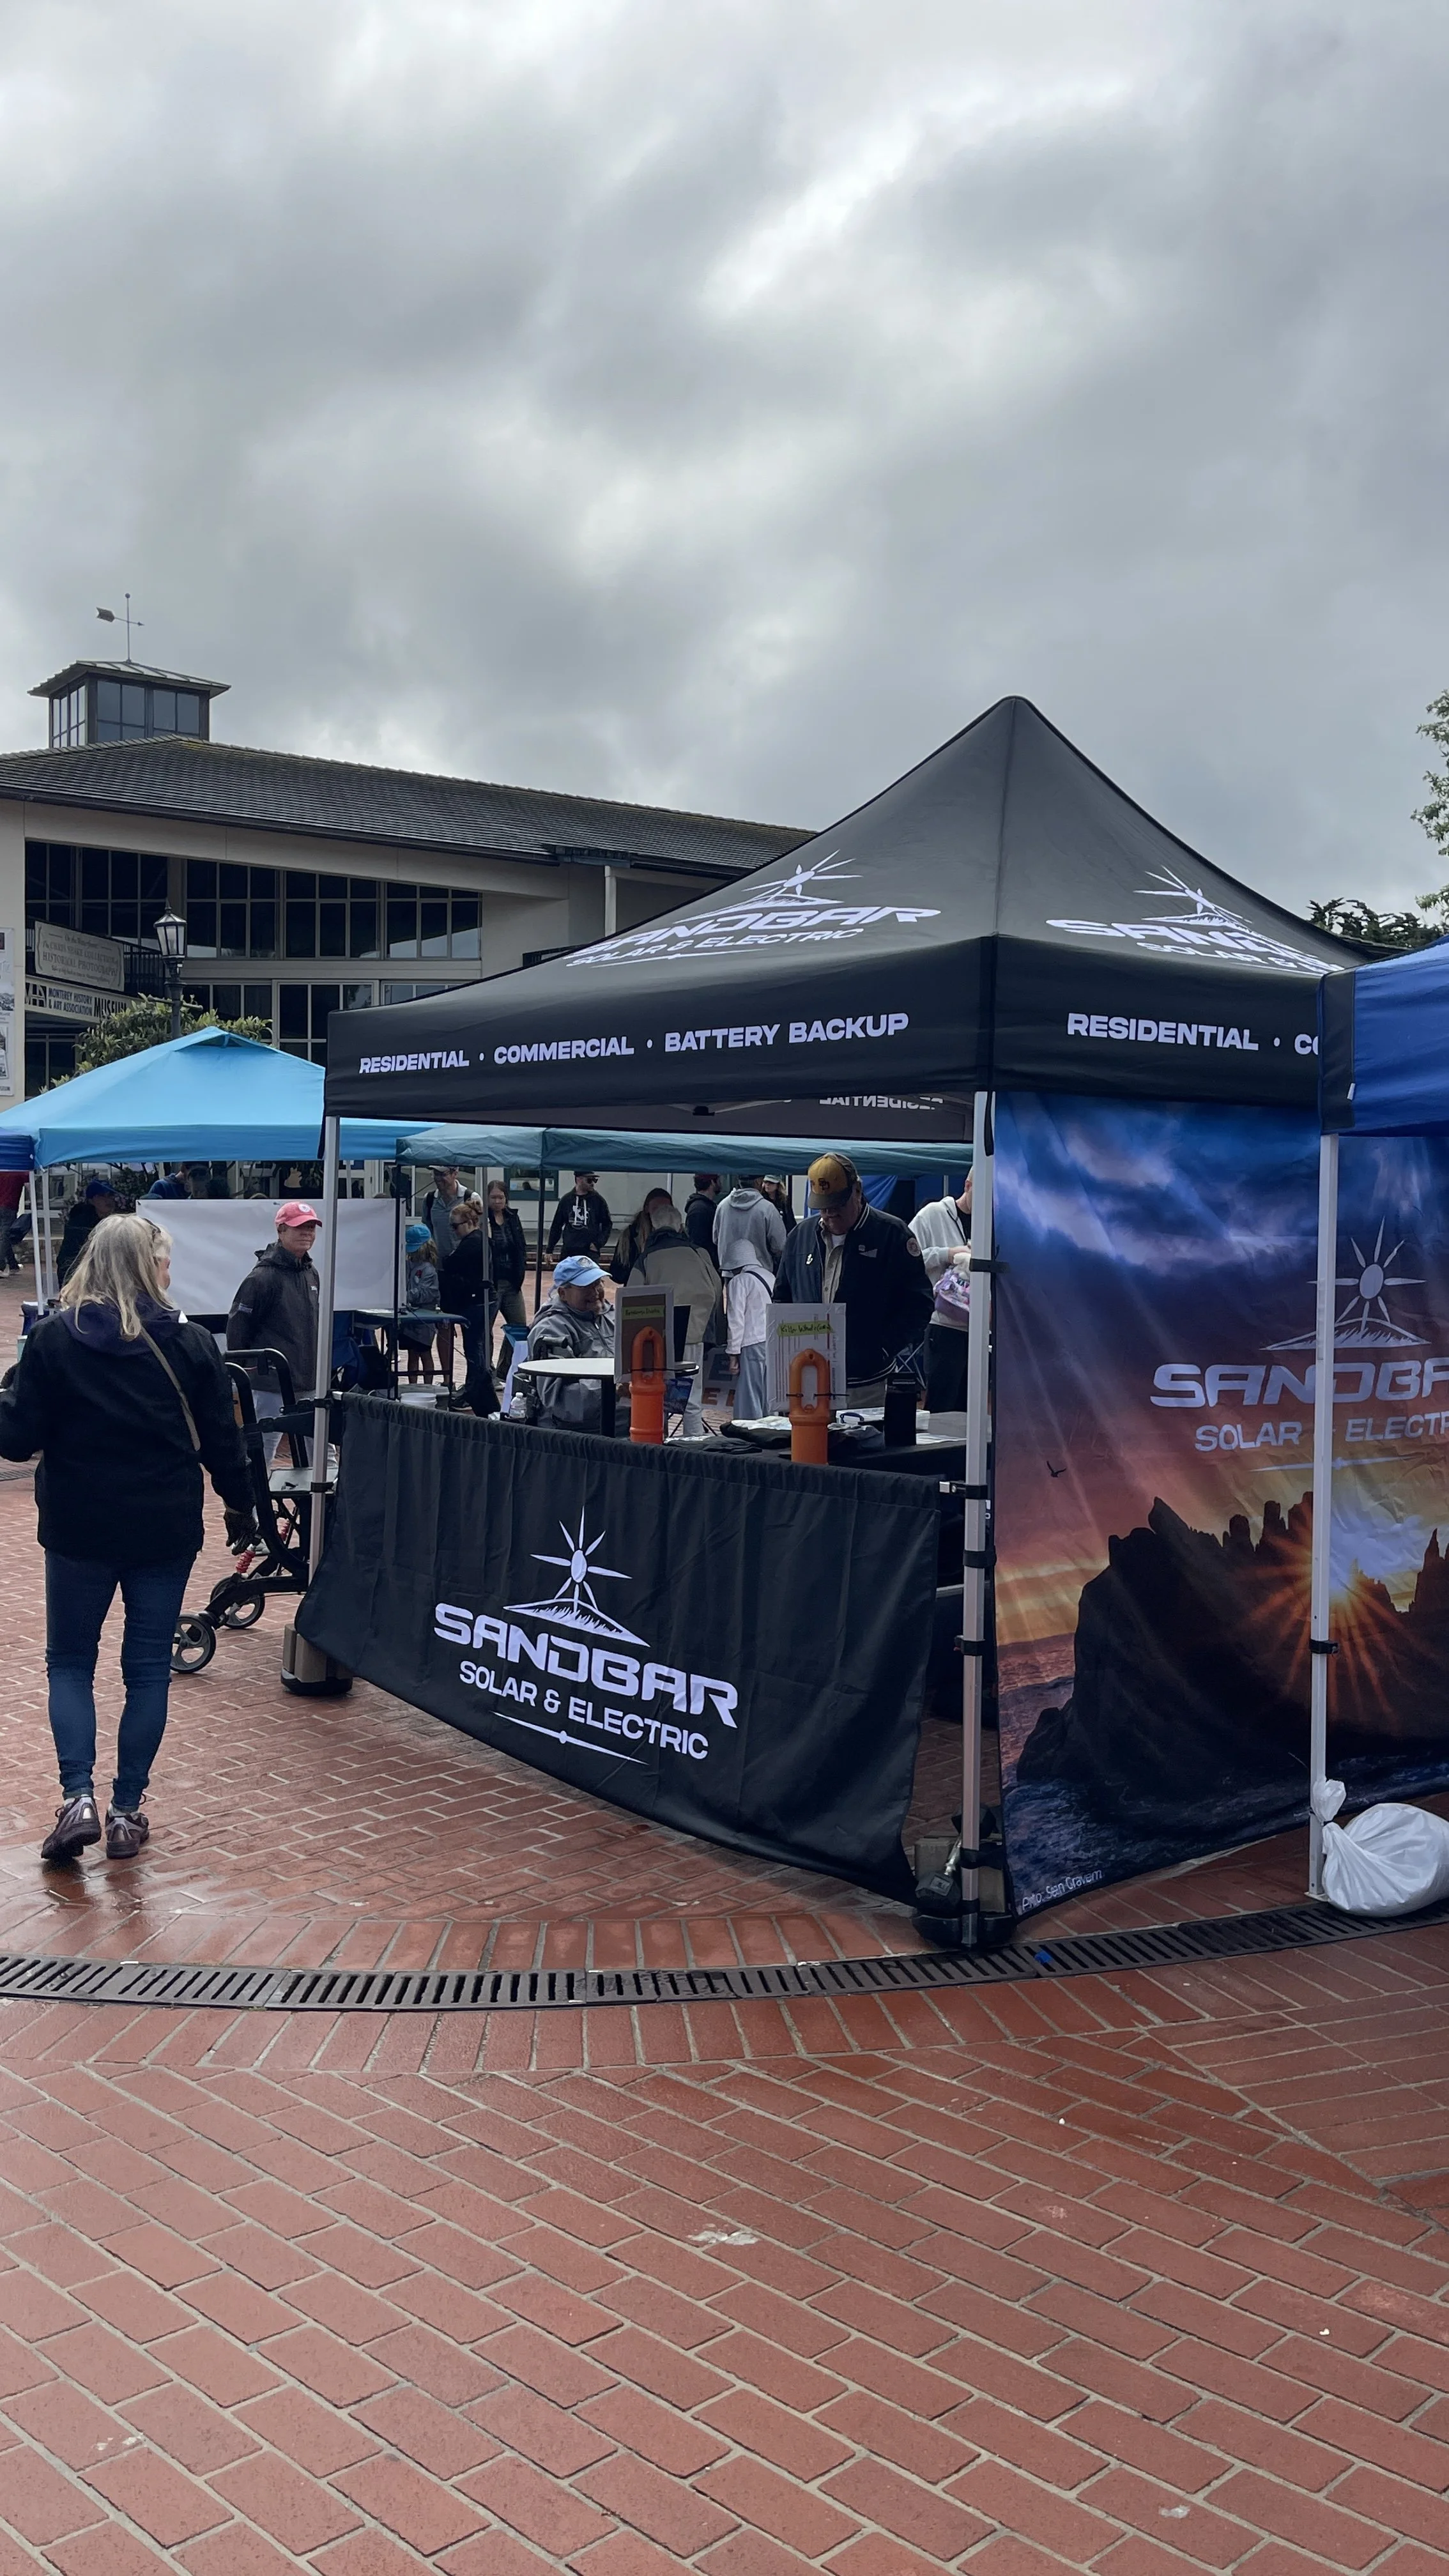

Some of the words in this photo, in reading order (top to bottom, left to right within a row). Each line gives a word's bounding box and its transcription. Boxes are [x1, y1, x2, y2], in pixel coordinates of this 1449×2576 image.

[563, 907, 941, 960] SANDBAR
[566, 943, 668, 967] SOLAR
[667, 940, 692, 951] &
[694, 928, 864, 949] ELECTRIC
[1045, 919, 1345, 970] SAND
[1137, 942, 1268, 964] SOLAR
[49, 988, 72, 1000] MONTEREY
[74, 992, 92, 1004] HISTORY
[54, 1000, 62, 1010] ART
[64, 1002, 93, 1016] ASSOCIATION
[359, 1050, 470, 1074] RESIDENTIAL
[493, 1036, 635, 1065] COMMERCIAL
[664, 1023, 781, 1053] BATTERY
[788, 1013, 910, 1044] BACKUP
[1068, 1013, 1259, 1051] RESIDENTIAL
[1194, 1421, 1303, 1452] SOLAR
[434, 1603, 738, 1728] SANDBAR
[459, 1661, 538, 1707] SOLAR
[543, 1689, 562, 1713] &
[568, 1696, 709, 1759] ELECTRIC
